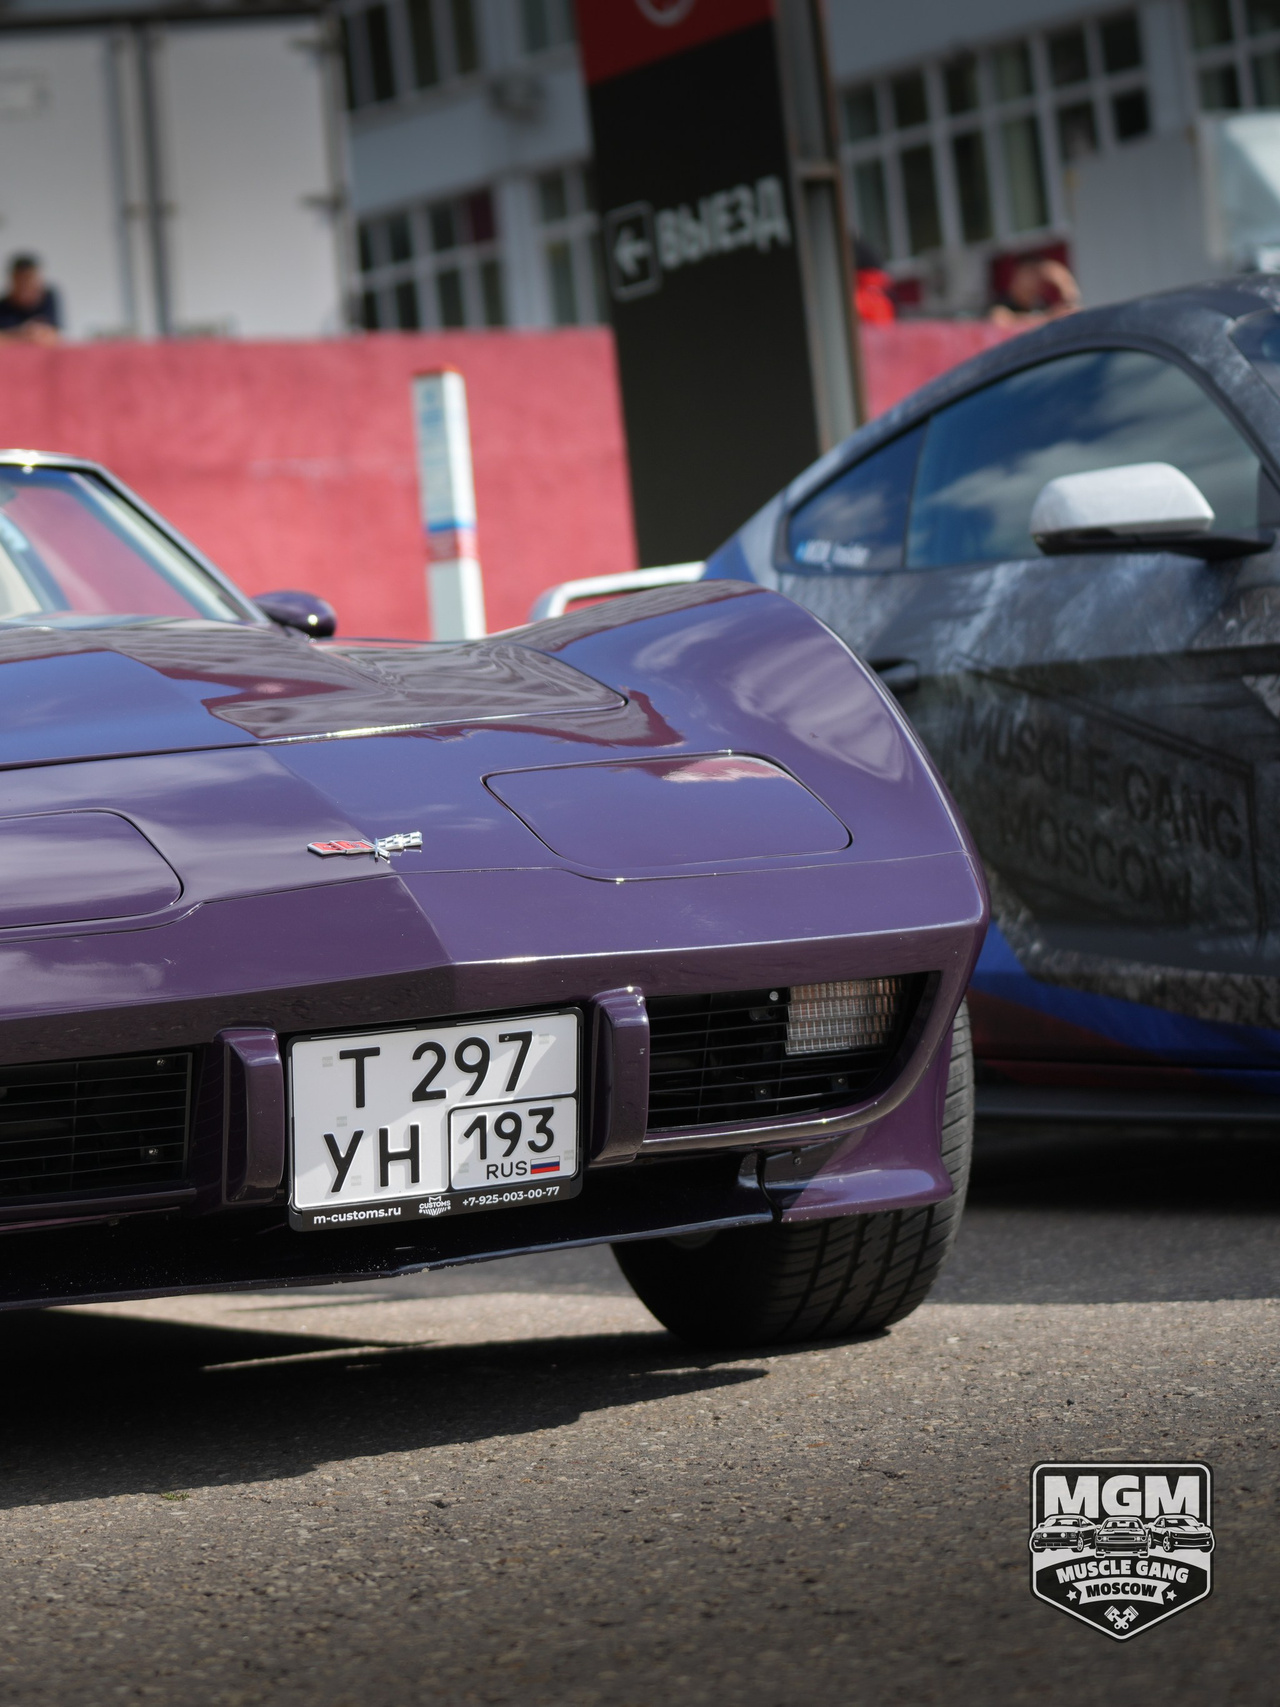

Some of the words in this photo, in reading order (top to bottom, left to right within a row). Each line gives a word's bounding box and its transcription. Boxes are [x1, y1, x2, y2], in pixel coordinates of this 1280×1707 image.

[655, 176, 792, 270] ВЫЕЗД
[959, 698, 1111, 806] MUSCLE
[1122, 762, 1243, 860] GANG
[999, 792, 1191, 920] MOSCOW
[411, 1030, 533, 1102] 297
[323, 1123, 420, 1192] УН
[463, 1106, 555, 1160] 193
[462, 1186, 560, 1207] +7-925-003-00-77
[486, 1160, 528, 1180] RUS
[313, 1206, 402, 1225] m-customs.ru
[419, 1200, 451, 1209] CUSTOMS
